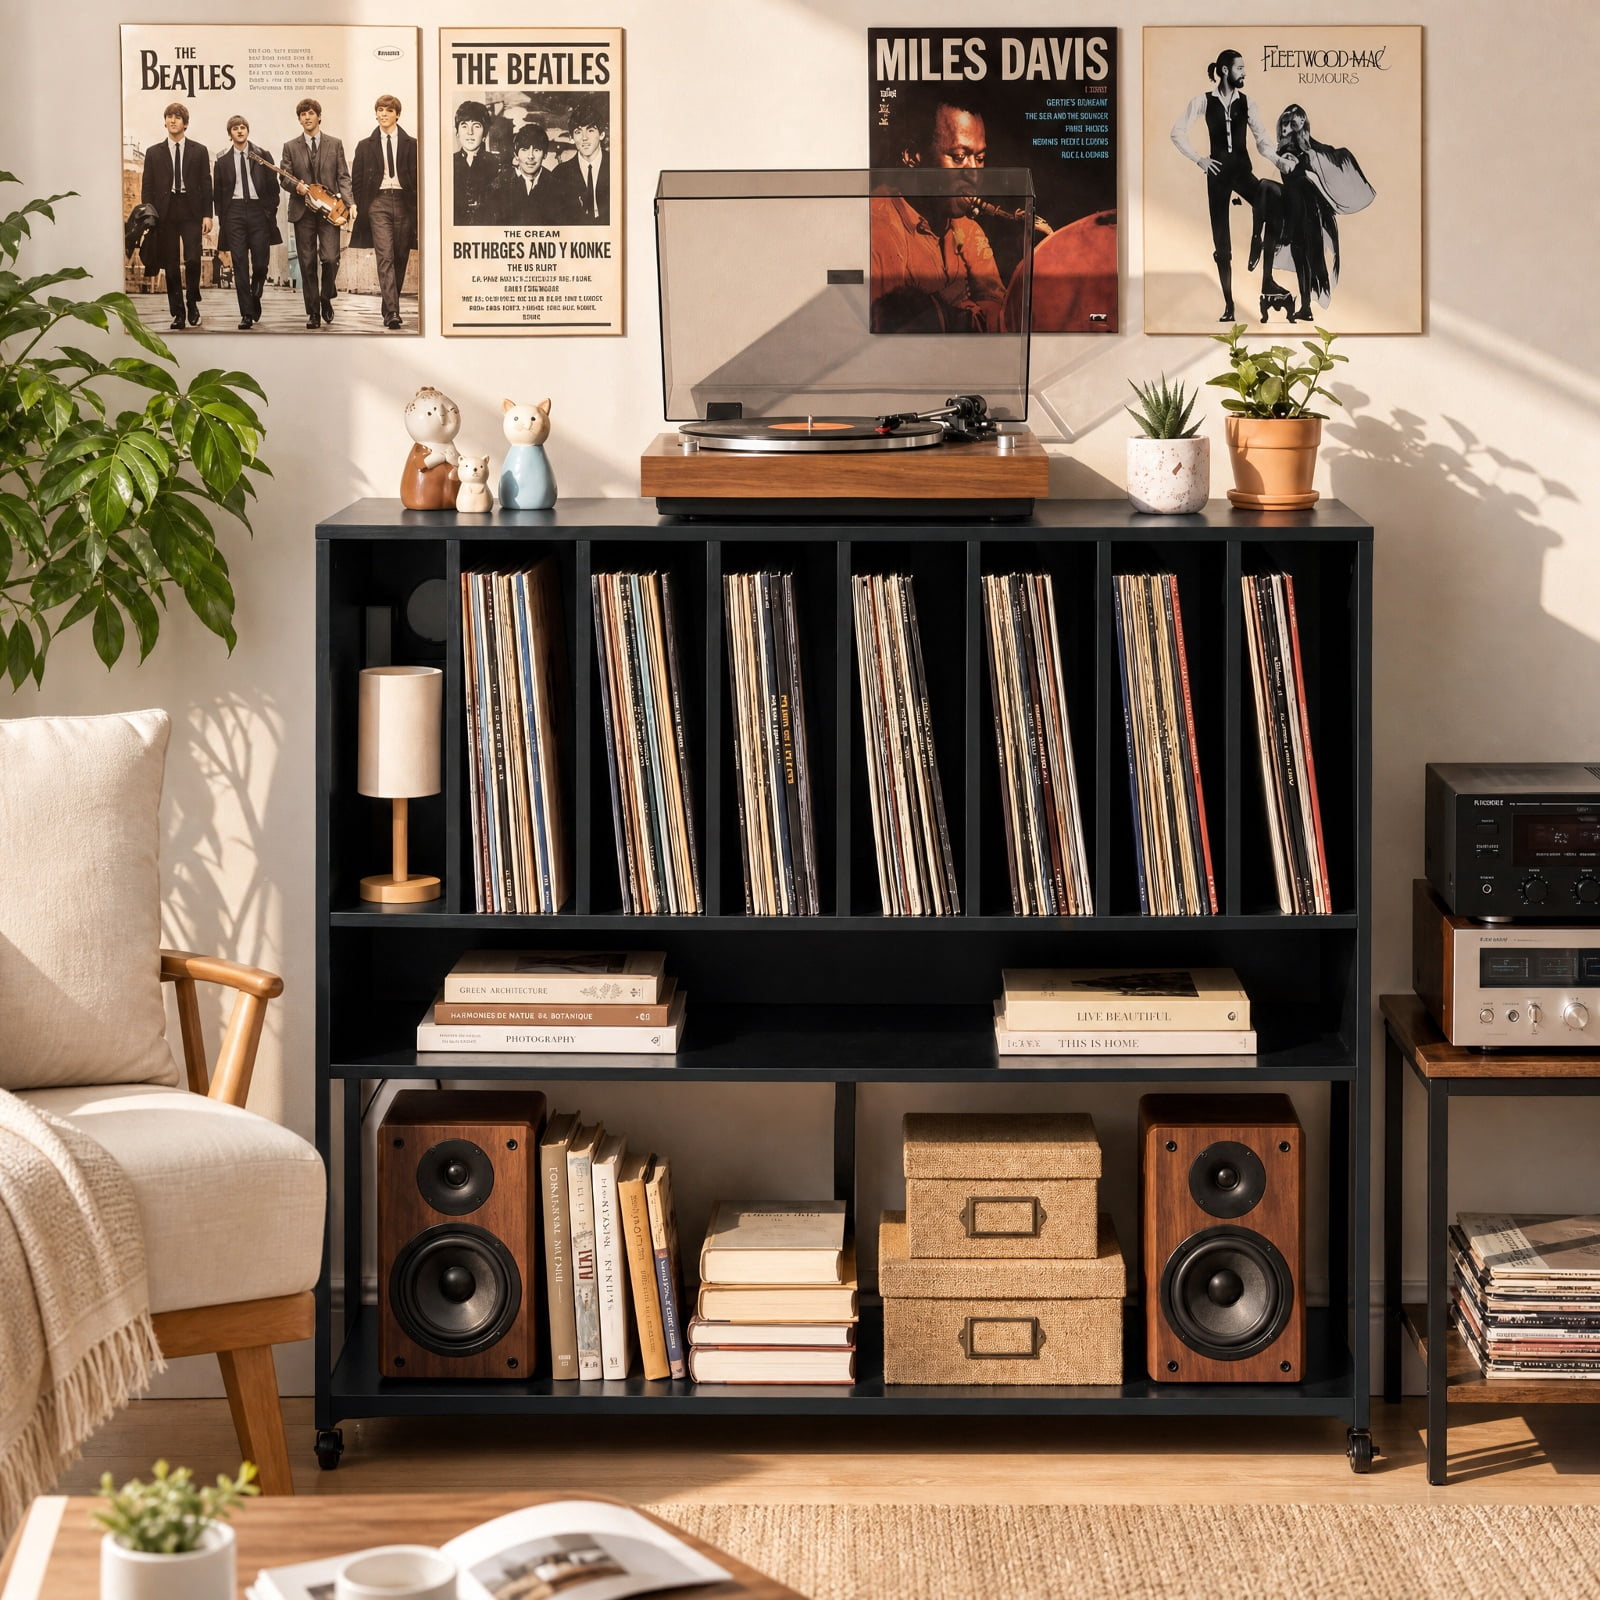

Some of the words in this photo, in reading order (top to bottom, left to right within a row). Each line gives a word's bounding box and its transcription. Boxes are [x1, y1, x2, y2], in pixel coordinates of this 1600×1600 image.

[174, 47, 197, 59] THE
[876, 37, 988, 81] MILES
[1001, 36, 1109, 81] DAVIS
[452, 52, 498, 85] THE
[507, 52, 610, 85] BEATLES
[1298, 72, 1360, 84] RUMOURS
[504, 230, 522, 238] THE
[524, 230, 560, 238] CREAM
[529, 241, 556, 259] AND
[559, 241, 568, 259] Y
[570, 241, 611, 259] KONKE
[507, 263, 522, 272] THE
[524, 263, 534, 272] US
[459, 986, 487, 995] GREEN
[490, 986, 548, 996] ARCHITECTURE
[450, 1011, 496, 1020] HARMONIES
[497, 1012, 508, 1020] DE
[550, 1013, 593, 1021] BOTANIQUE
[1077, 1011, 1103, 1022] LIVE
[1105, 1011, 1172, 1022] BEAUTIFUL
[505, 1034, 577, 1045] PHOTOGRAPHY
[1057, 1038, 1088, 1049] THIS
[1090, 1038, 1103, 1049] IS
[1104, 1038, 1140, 1049] HOME
